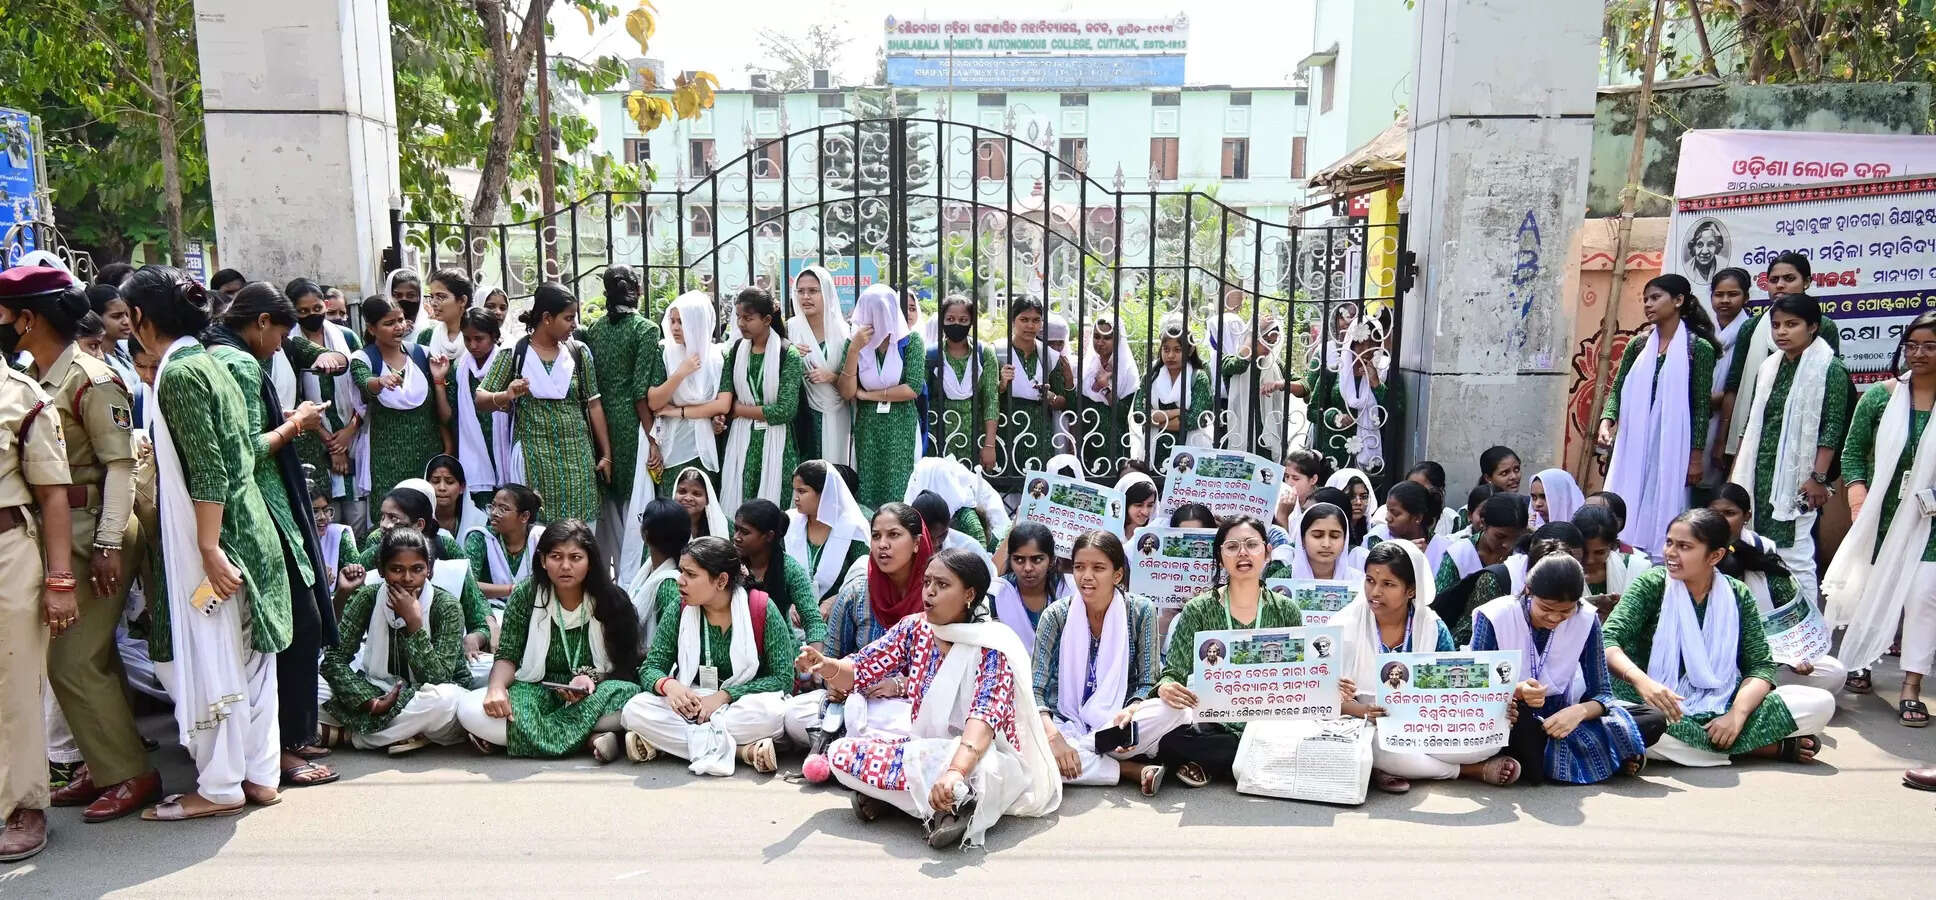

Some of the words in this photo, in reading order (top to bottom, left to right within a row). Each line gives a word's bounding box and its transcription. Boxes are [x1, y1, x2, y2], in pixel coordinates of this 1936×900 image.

[888, 39, 939, 50] SHAILABALA
[988, 39, 1047, 49] AUTONOMOUS
[1732, 155, 1788, 179] ଓଡ଼ିଶା
[1792, 161, 1849, 178] ଲୋକ
[1819, 240, 1863, 262] ମହିଳା
[1245, 667, 1278, 679] ବେଳେ
[1231, 696, 1264, 706] ବେଳେ
[1384, 691, 1437, 704] ଶୈଳବାଳା
[1403, 722, 1443, 733] ମାନ୍ୟତା
